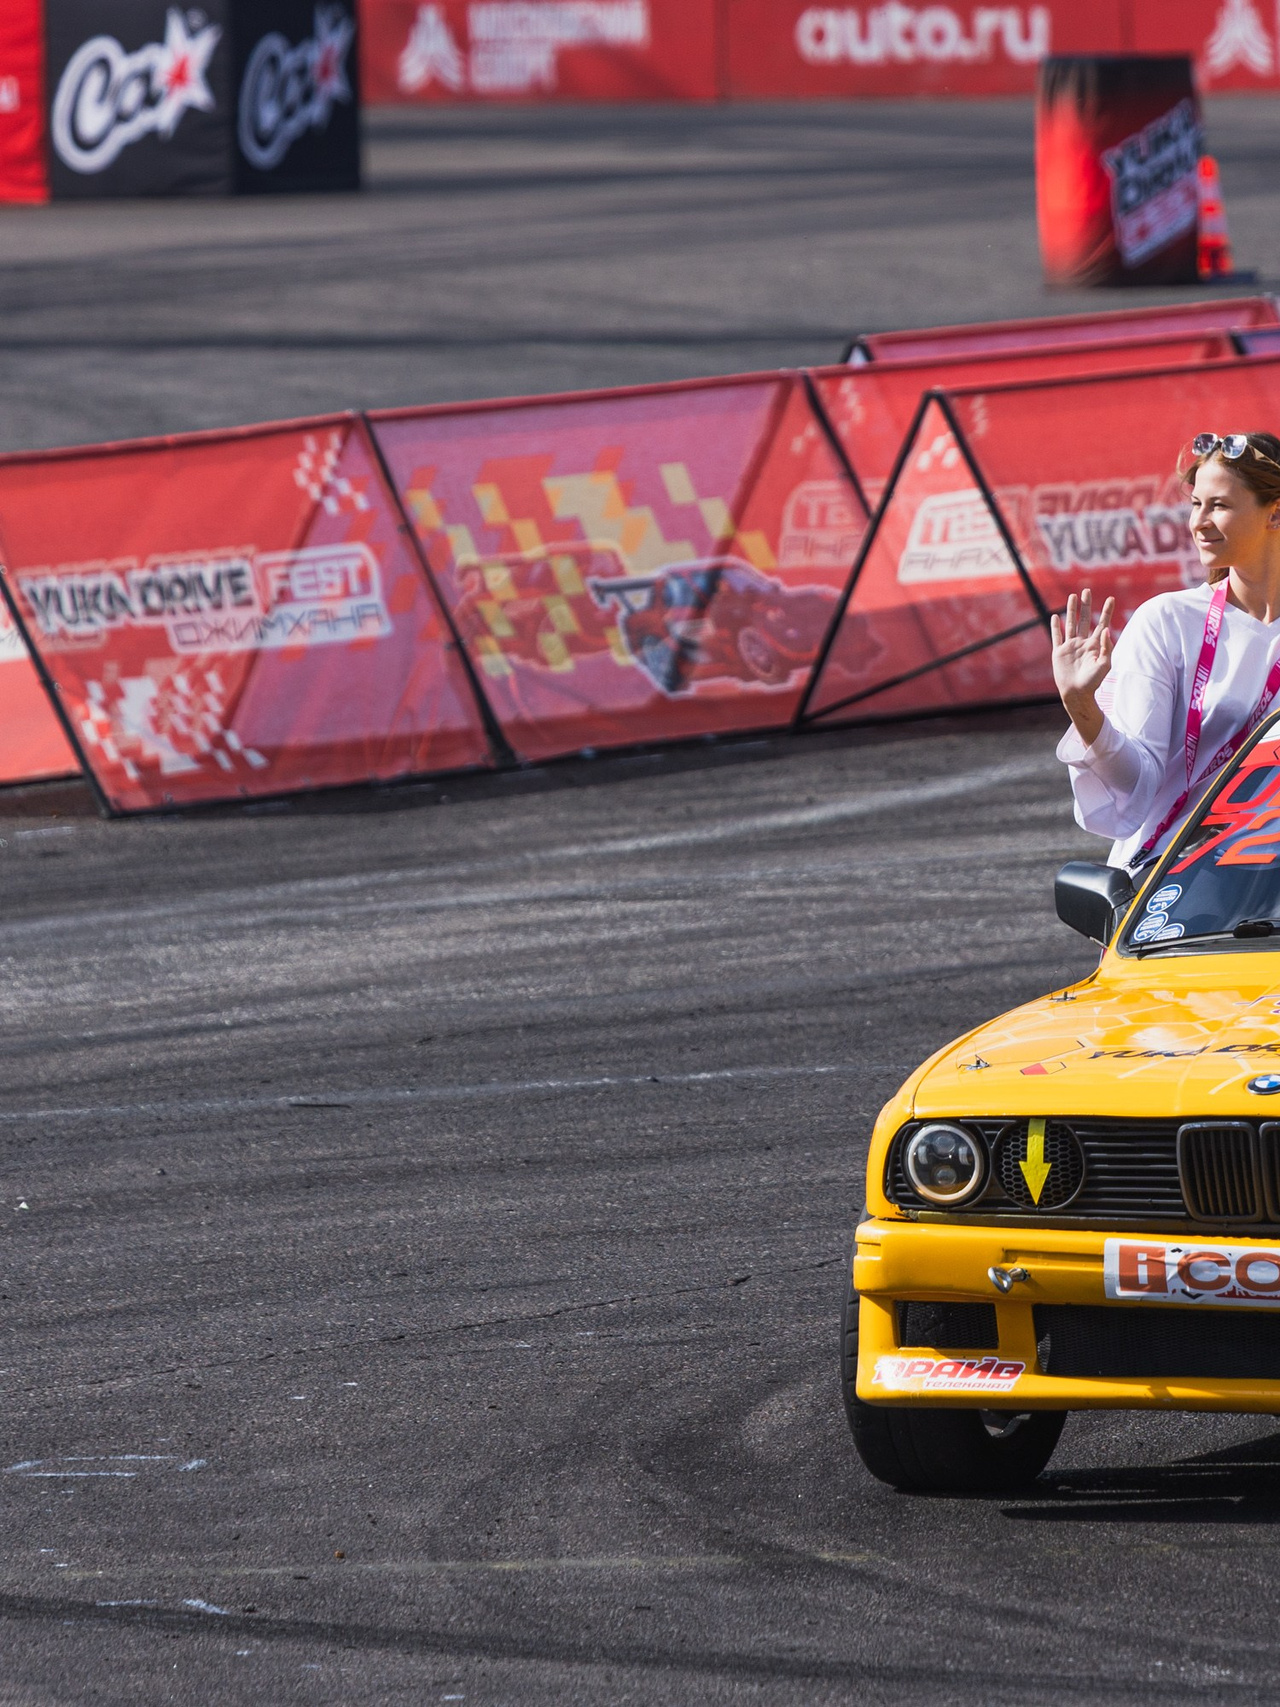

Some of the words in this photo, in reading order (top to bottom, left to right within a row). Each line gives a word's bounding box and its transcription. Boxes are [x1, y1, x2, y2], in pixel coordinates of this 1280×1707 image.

[796, 4, 1050, 64] auto.ru
[1042, 514, 1147, 565] YUKA
[28, 574, 133, 629] YUKA
[138, 564, 254, 618] DRIVE
[268, 557, 368, 602] FEST
[173, 602, 385, 646] ДЖИМХАНА
